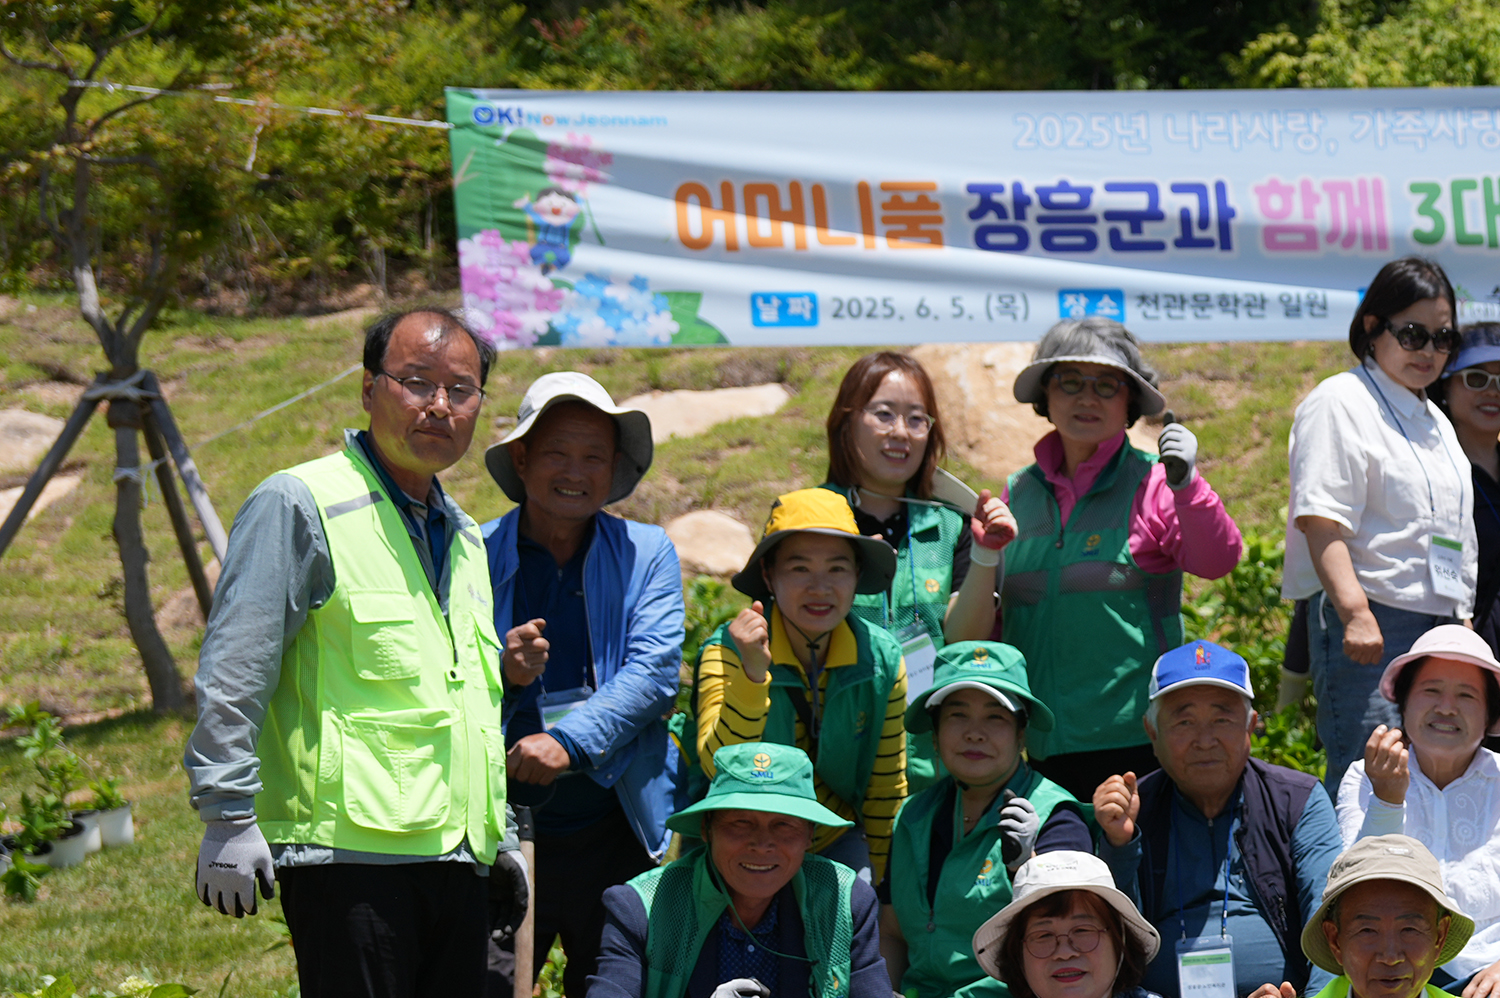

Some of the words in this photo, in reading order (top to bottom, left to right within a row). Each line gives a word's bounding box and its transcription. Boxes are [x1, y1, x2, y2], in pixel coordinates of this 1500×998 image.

[473, 105, 524, 126] OK!
[574, 111, 669, 127] Jeonnam
[1014, 108, 1151, 154] 2025년
[1166, 107, 1339, 155] 나라사랑,
[673, 180, 946, 252] 어머니품
[965, 179, 1237, 252] 장흥군과
[1252, 176, 1391, 252] 함께
[831, 296, 905, 321] 2025.
[915, 296, 940, 321] 6.
[951, 296, 974, 321] 5.
[985, 292, 1030, 321] (목)
[1135, 290, 1268, 320] 천관문학관
[1277, 289, 1329, 320] 일원
[750, 771, 774, 779] SMU
